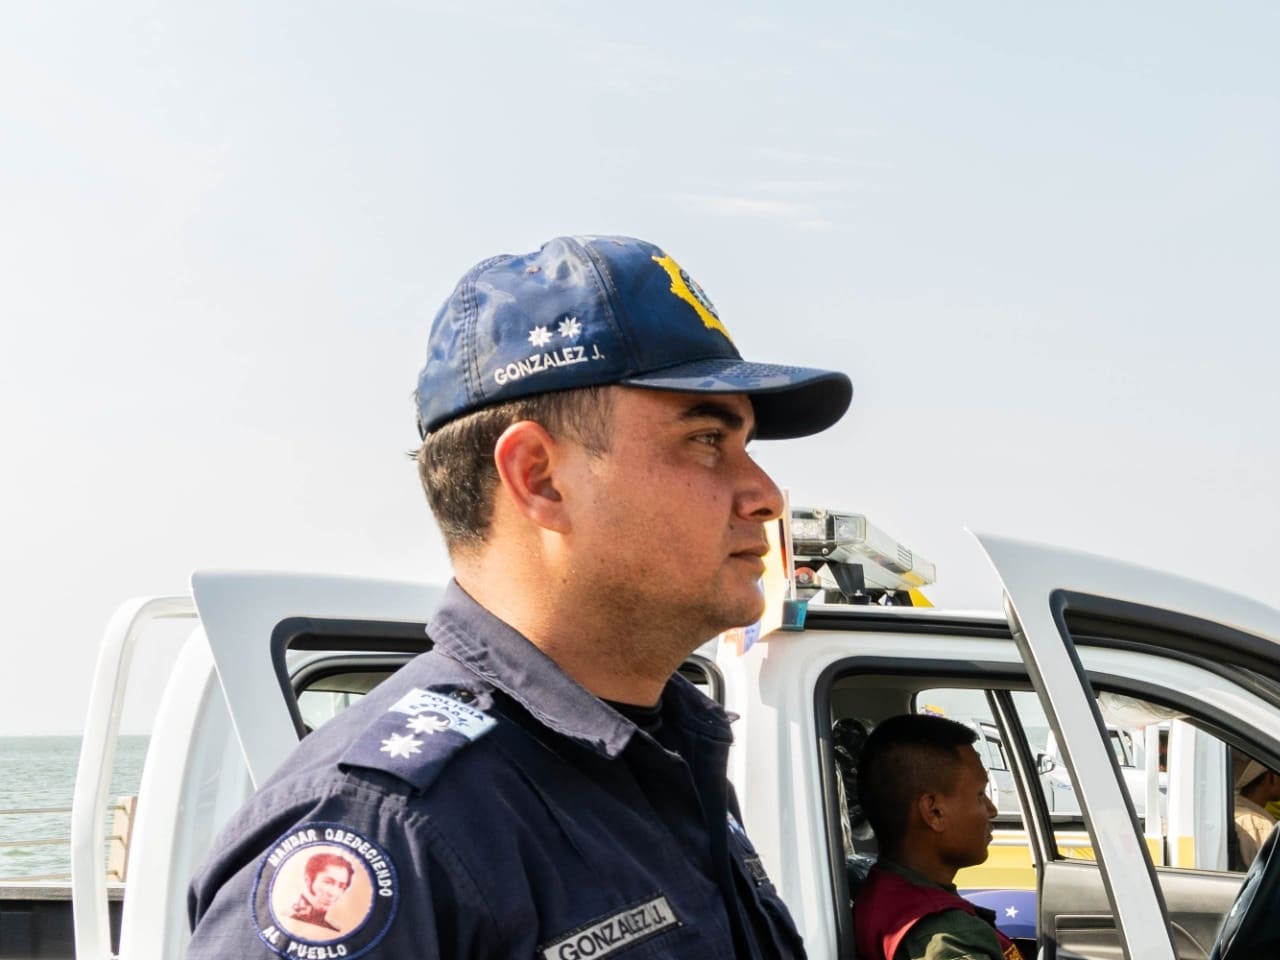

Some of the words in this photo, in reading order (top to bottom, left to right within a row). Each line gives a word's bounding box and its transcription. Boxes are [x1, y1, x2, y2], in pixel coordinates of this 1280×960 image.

[494, 346, 588, 385] GONZALEZ
[591, 344, 606, 360] J.
[268, 829, 317, 867] MANDAR
[324, 828, 393, 897] OBEDECIENDO
[652, 905, 667, 924] J.
[262, 926, 280, 944] AL
[286, 941, 347, 959] PUEBLO
